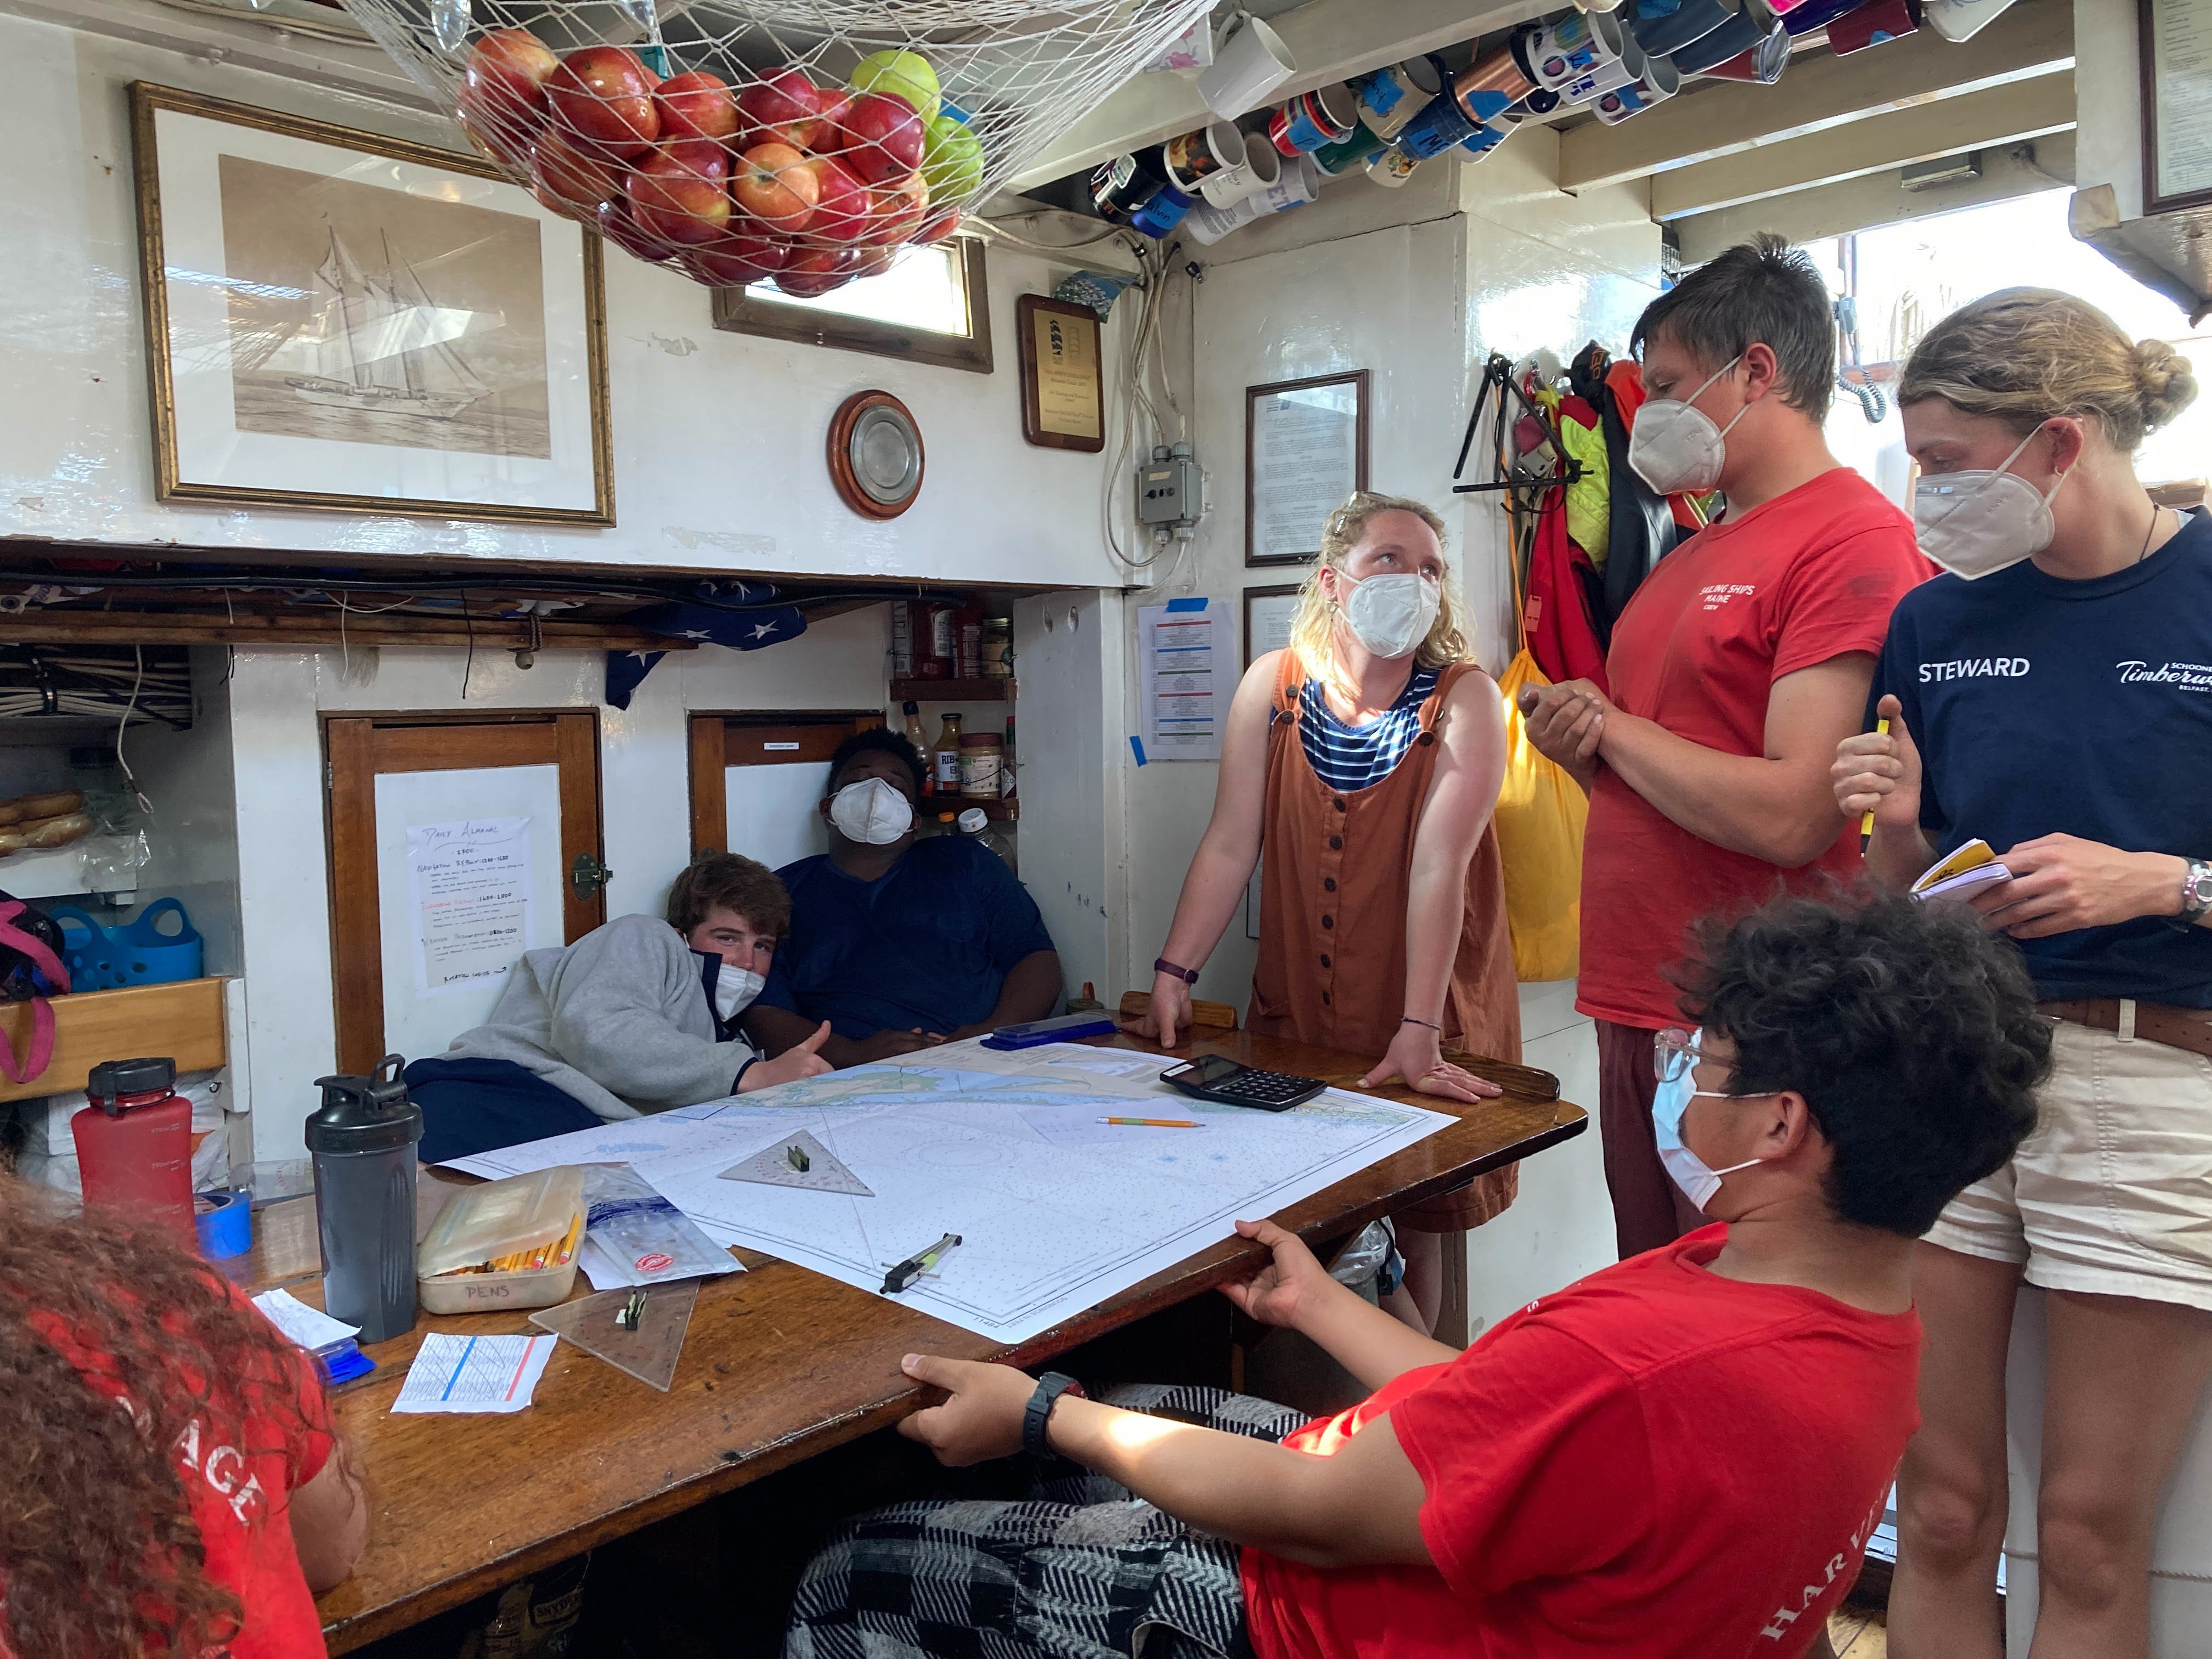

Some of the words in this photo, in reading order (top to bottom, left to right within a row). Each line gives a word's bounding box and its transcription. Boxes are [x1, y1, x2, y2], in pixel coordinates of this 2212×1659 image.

[1727, 584, 1756, 596] SHIPS
[1703, 595, 1730, 603] MAINE
[1919, 658, 2030, 682] STEWARD
[465, 1285, 510, 1298] PENS
